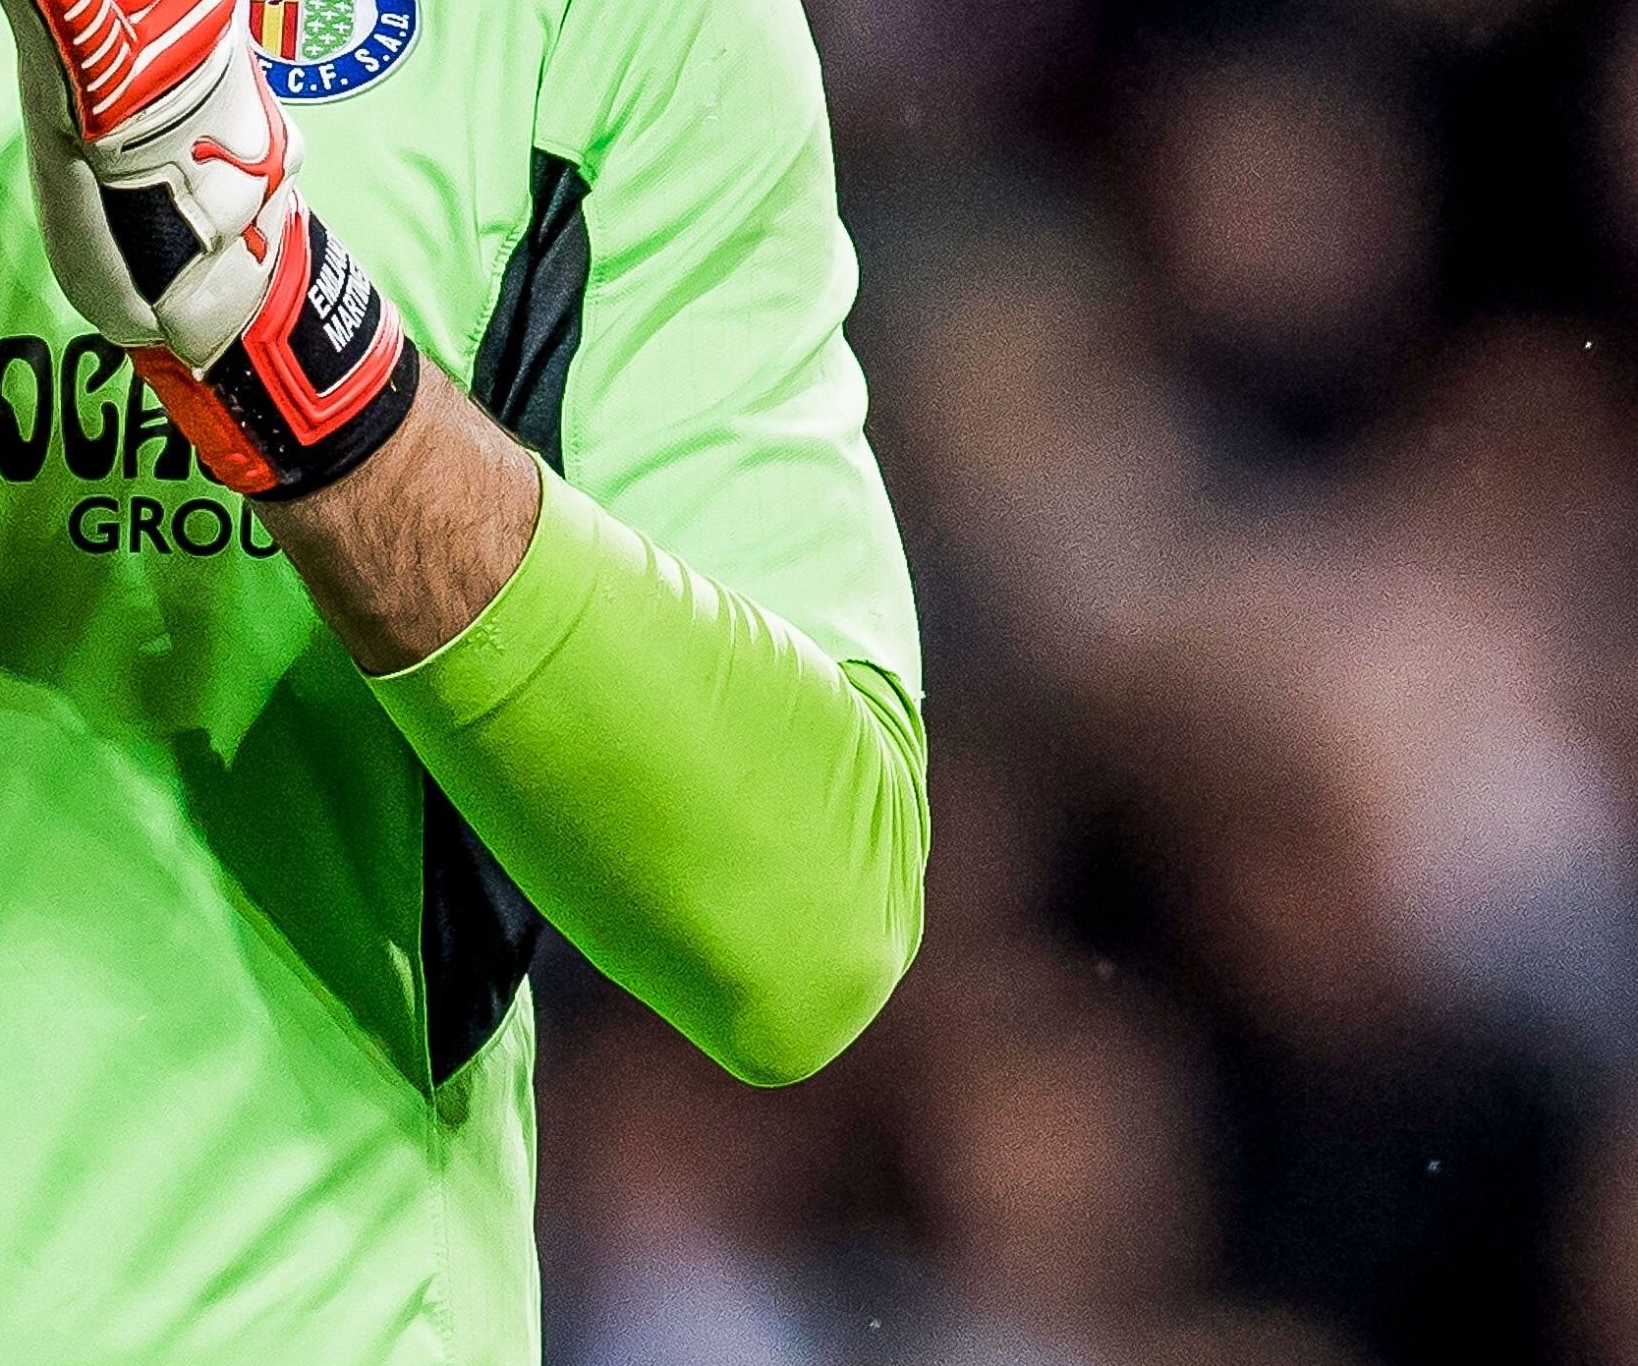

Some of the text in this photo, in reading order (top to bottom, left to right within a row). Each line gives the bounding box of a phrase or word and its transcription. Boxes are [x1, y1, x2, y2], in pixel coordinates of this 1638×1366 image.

[288, 63, 348, 93] C.F.
[323, 254, 371, 353] MARTINE
[68, 497, 282, 560] GROU
